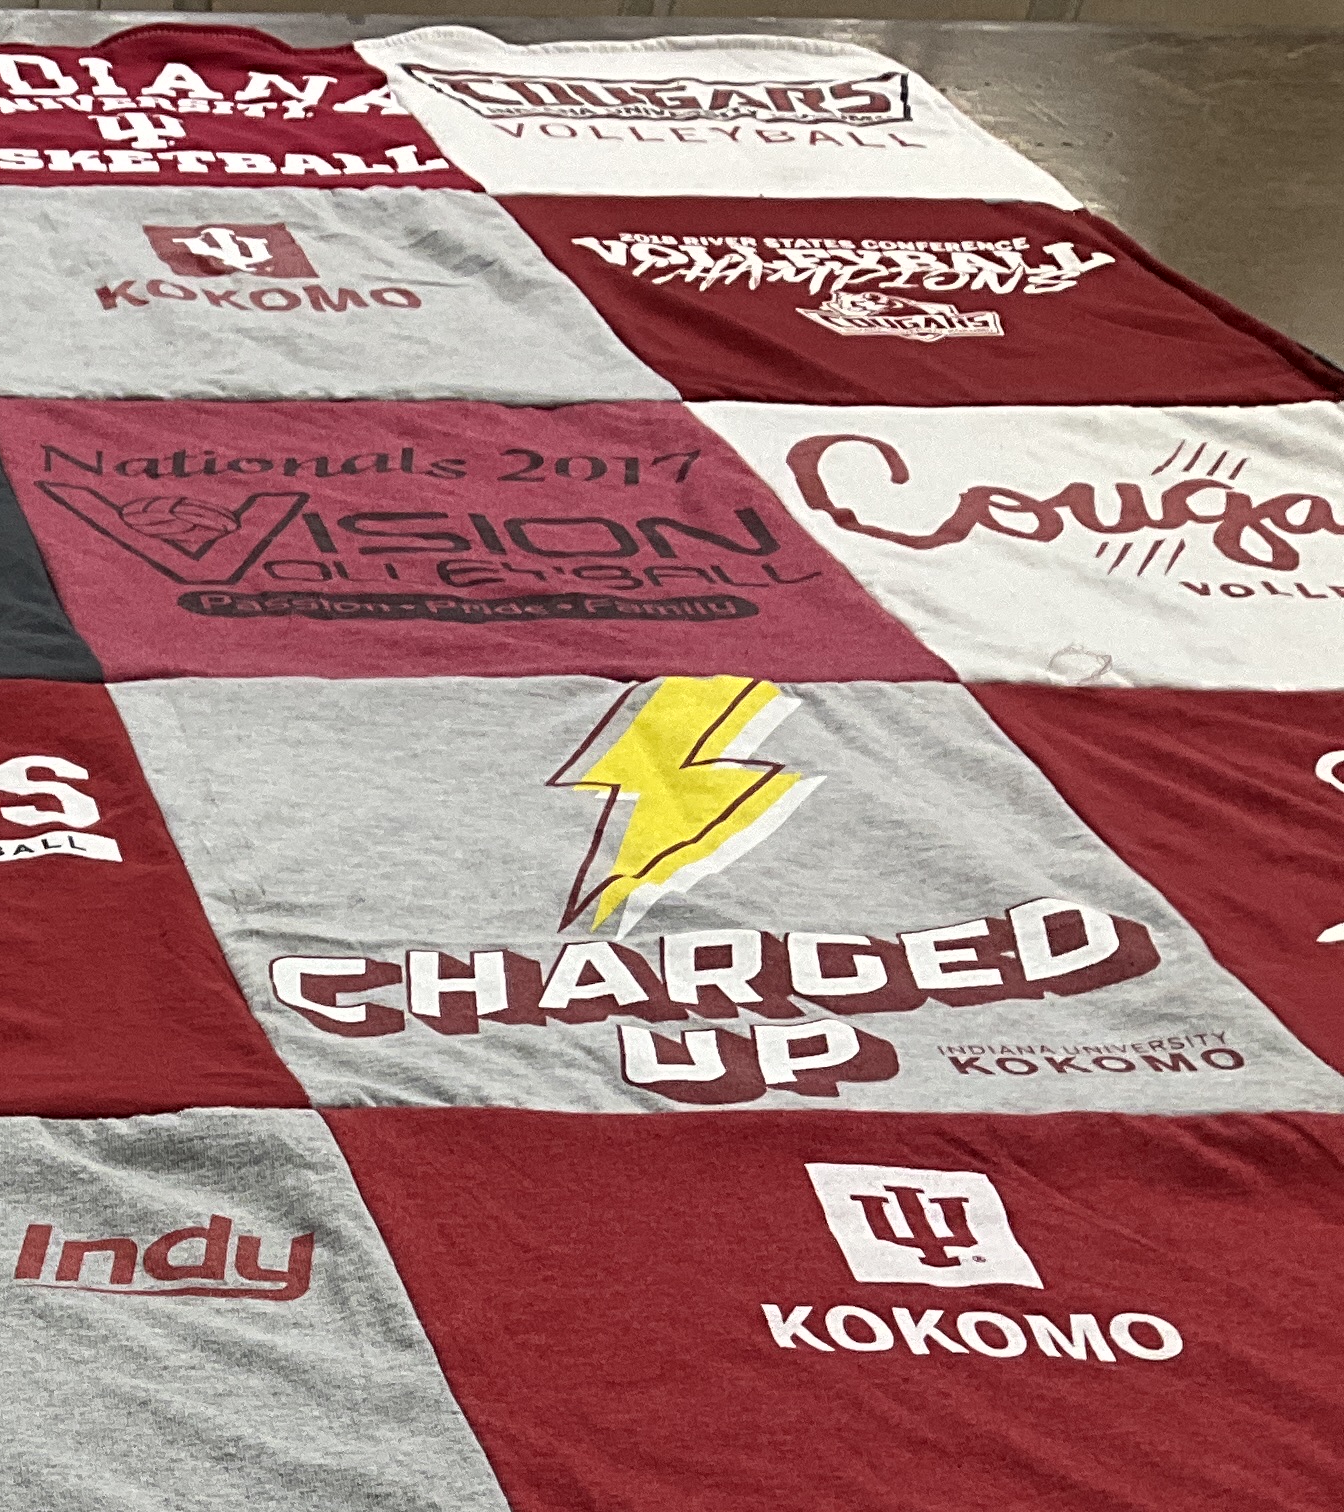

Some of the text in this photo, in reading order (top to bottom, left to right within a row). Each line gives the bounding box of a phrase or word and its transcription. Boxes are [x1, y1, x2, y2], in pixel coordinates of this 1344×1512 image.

[436, 78, 892, 114] COUGARS
[491, 122, 928, 149] VOLLEYBALL
[682, 236, 758, 248] RIVER
[763, 237, 855, 250] STATES
[861, 237, 1030, 252] CONFERENCE
[95, 278, 422, 312] KOKOMO
[40, 444, 701, 487] Nationals 2017
[270, 895, 1150, 1034] CHARGED
[618, 1017, 892, 1100] UP
[937, 1030, 1227, 1056] INDIANA UNIVERSITY
[948, 1047, 1246, 1076] KOKOMO
[12, 1213, 316, 1302] Indy
[760, 1302, 1184, 1363] KOKOMO
